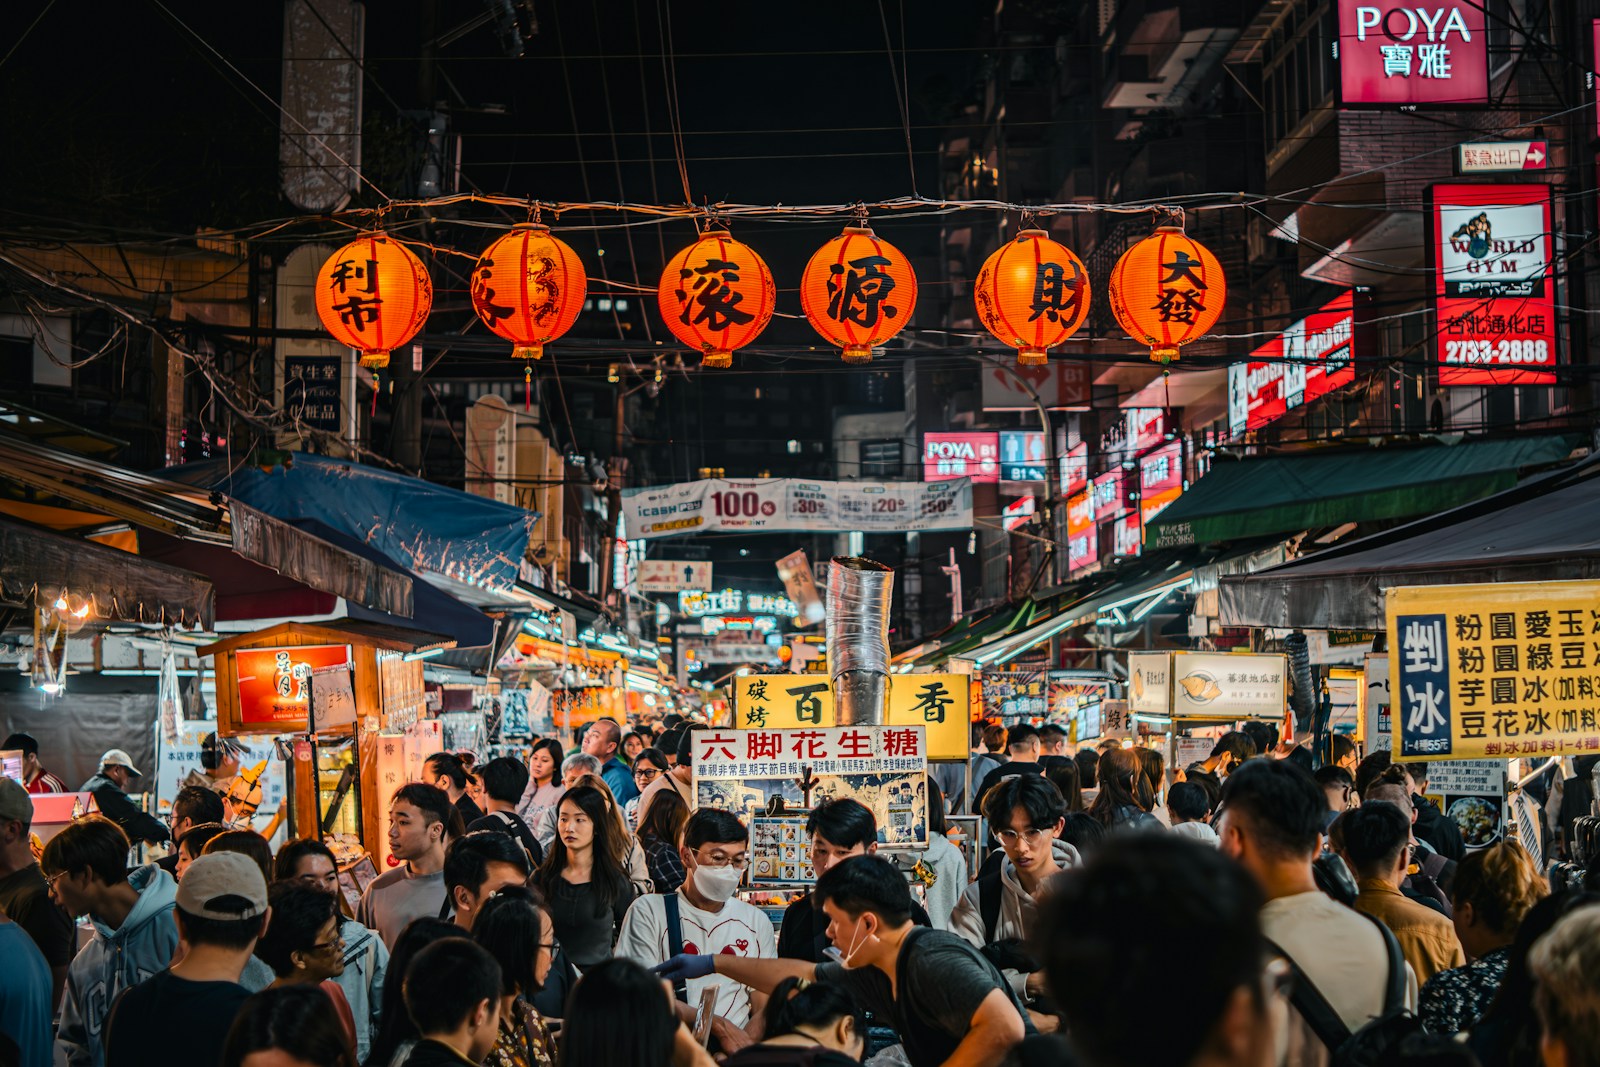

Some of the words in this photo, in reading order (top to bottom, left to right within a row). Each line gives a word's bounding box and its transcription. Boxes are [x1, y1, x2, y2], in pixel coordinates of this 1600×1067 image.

[1356, 7, 1472, 43] POYA
[1380, 43, 1452, 79] 寶雅
[1464, 149, 1522, 167] 緊急出口
[1466, 260, 1518, 273] GYM
[330, 259, 384, 332] 利市
[675, 259, 755, 332] 滾
[826, 255, 898, 329] 源
[1027, 260, 1088, 329] 財
[1150, 250, 1209, 325] 大發
[1446, 340, 1549, 364] 2733-2888
[928, 442, 975, 459] POYA
[981, 444, 996, 456] B1
[1011, 468, 1026, 479] B1
[1404, 621, 1447, 734] 剉冰
[746, 679, 771, 728] 碳烤
[701, 729, 918, 760] 六脚花生糖
